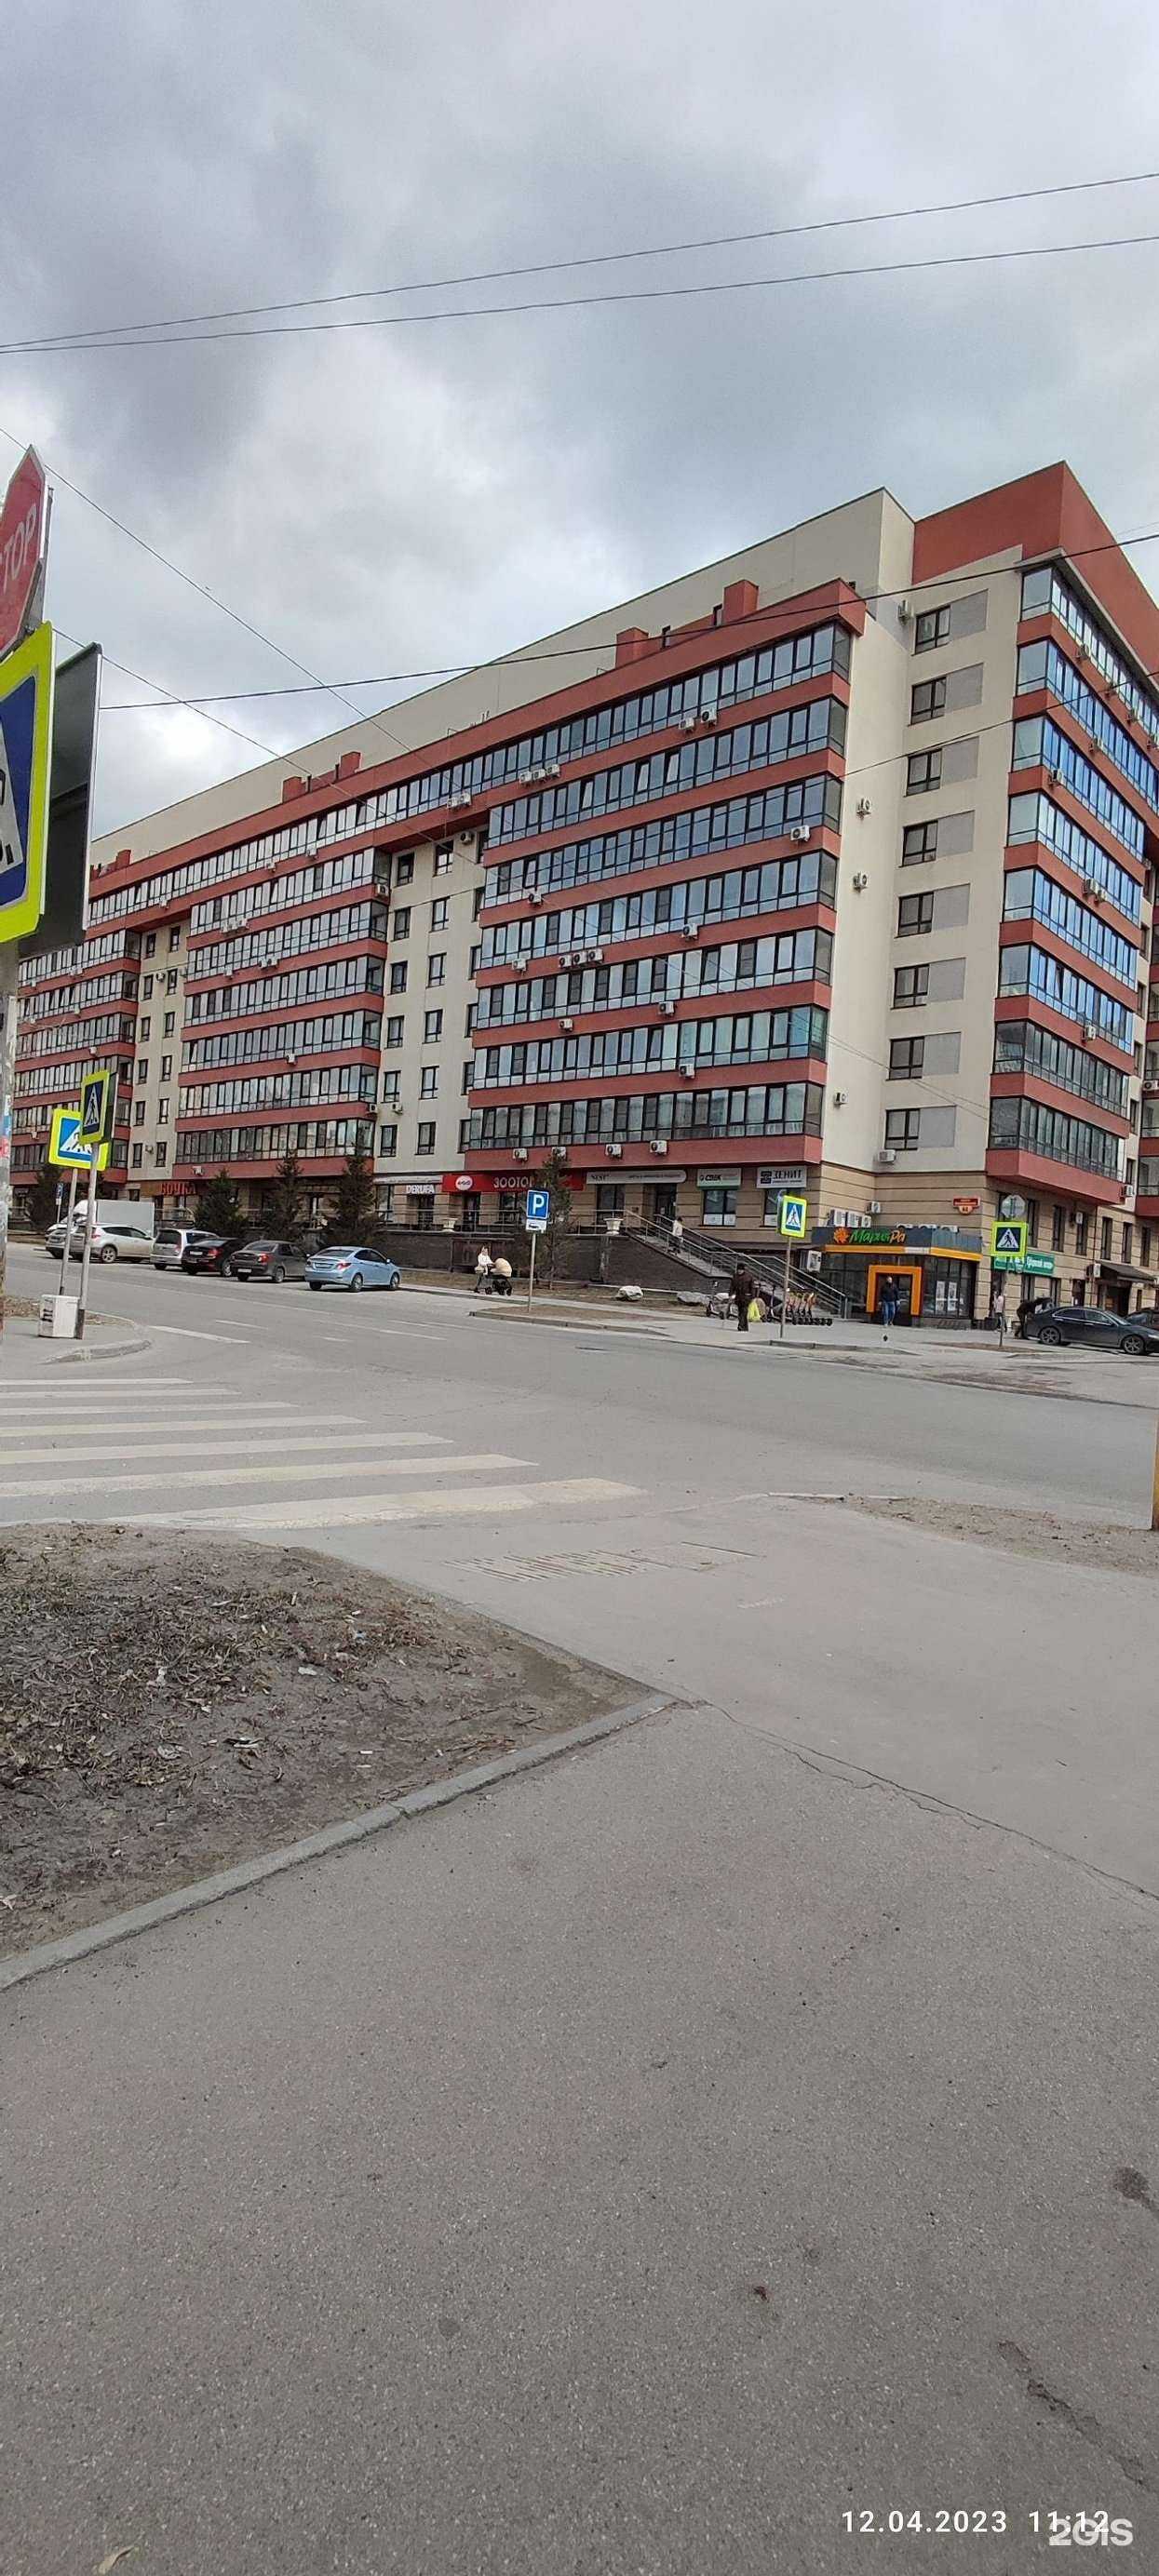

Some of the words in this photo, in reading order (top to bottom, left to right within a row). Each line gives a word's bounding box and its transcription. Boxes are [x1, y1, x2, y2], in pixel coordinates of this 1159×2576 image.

[0, 503, 36, 594] TOP
[774, 1170, 802, 1180] ЗЕНИТ
[406, 1184, 435, 1194] DERUFA
